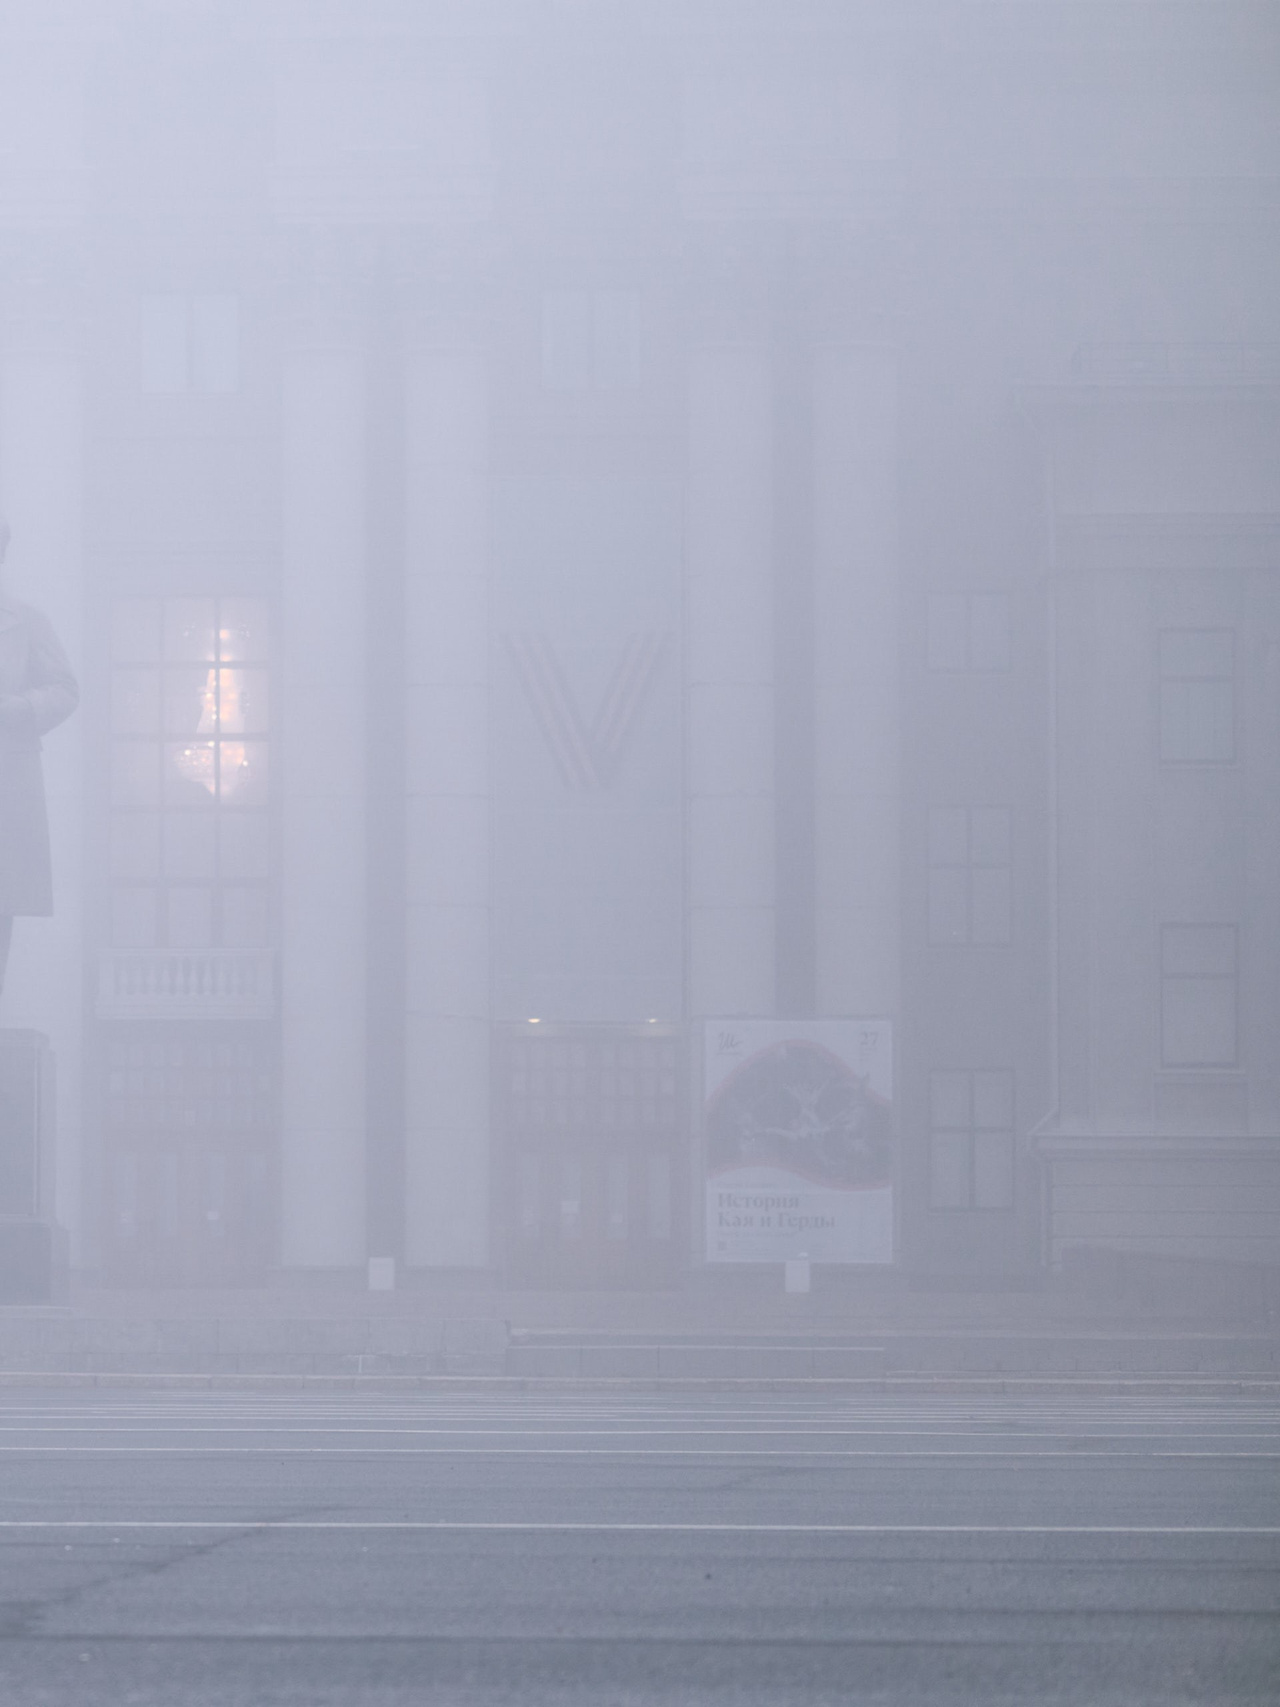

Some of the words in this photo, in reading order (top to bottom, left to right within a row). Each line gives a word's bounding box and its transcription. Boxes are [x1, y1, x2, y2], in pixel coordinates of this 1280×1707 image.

[498, 629, 676, 791] V
[859, 1030, 879, 1046] 27
[718, 1193, 800, 1212] История
[718, 1212, 754, 1228] Кая
[760, 1215, 772, 1228] и
[777, 1212, 835, 1232] Герды
